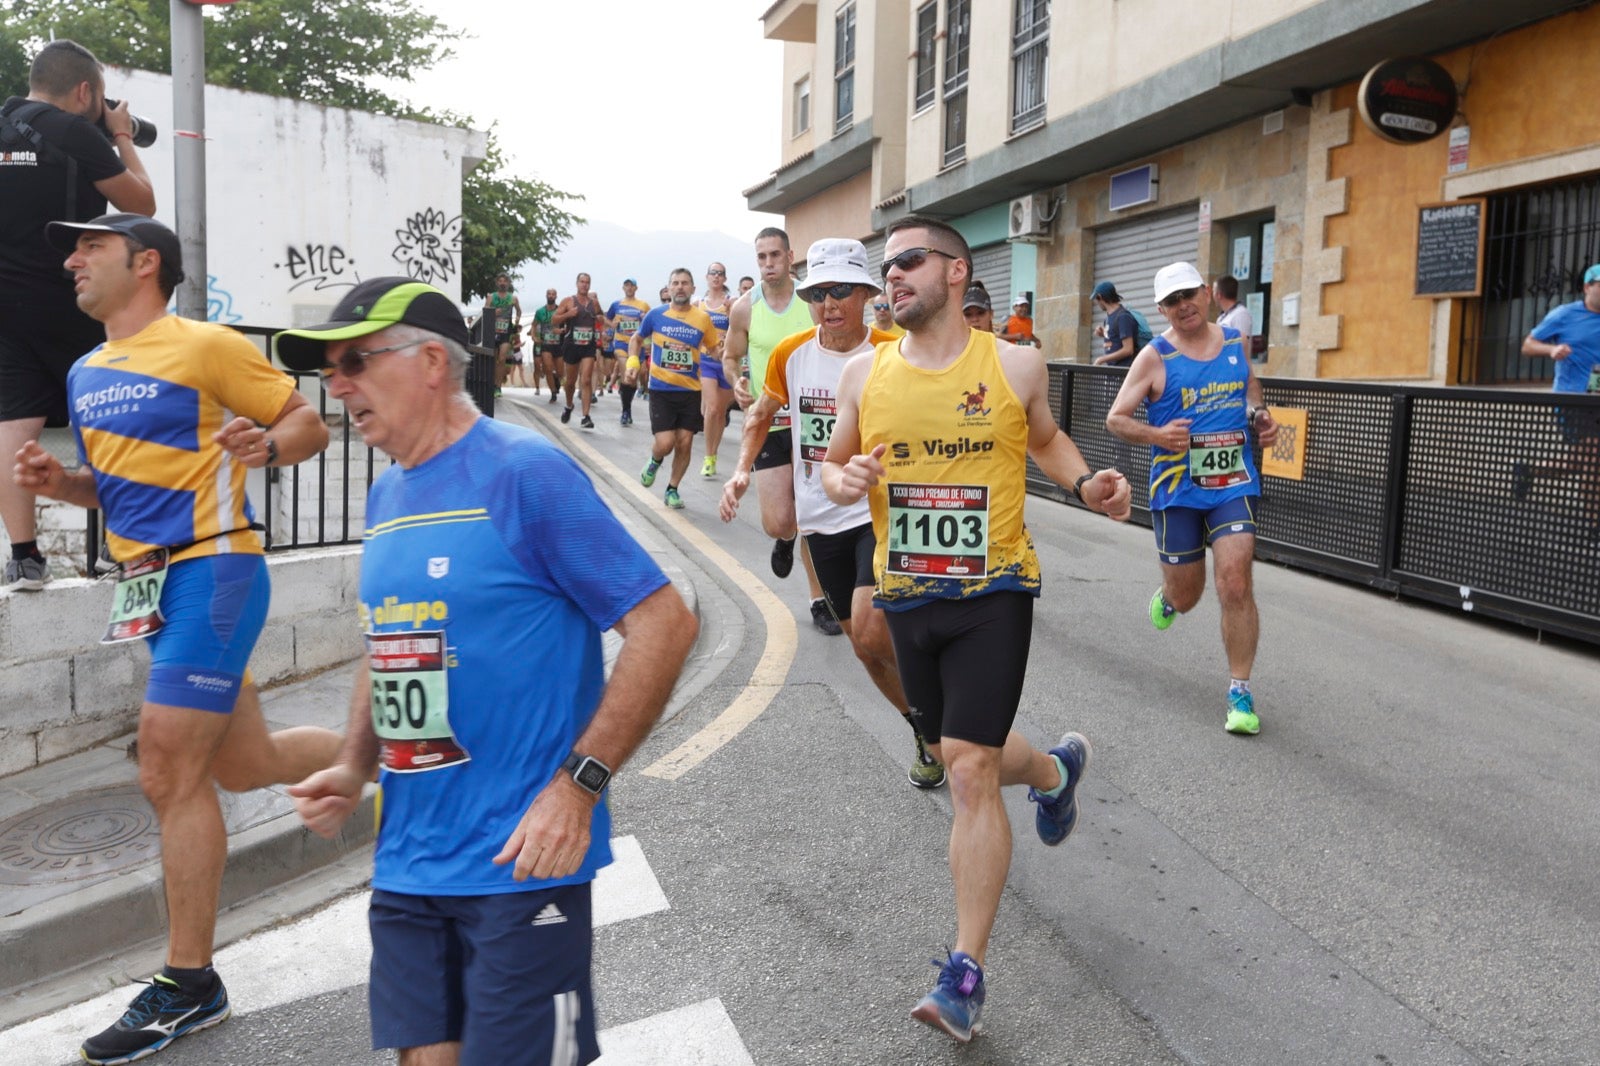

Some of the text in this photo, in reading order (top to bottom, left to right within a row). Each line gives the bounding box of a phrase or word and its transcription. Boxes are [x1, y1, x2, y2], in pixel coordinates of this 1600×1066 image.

[661, 325, 698, 335] agustinos
[667, 350, 688, 363] 833
[1200, 382, 1244, 396] olimpo
[923, 437, 994, 459] Vigilsa
[909, 488, 924, 498] GRAN
[925, 488, 950, 499] PREMIO
[951, 489, 959, 499] DE
[961, 489, 982, 500] FONDO
[896, 513, 983, 548] 1103
[123, 578, 158, 614] 840
[375, 596, 448, 629] olimpo
